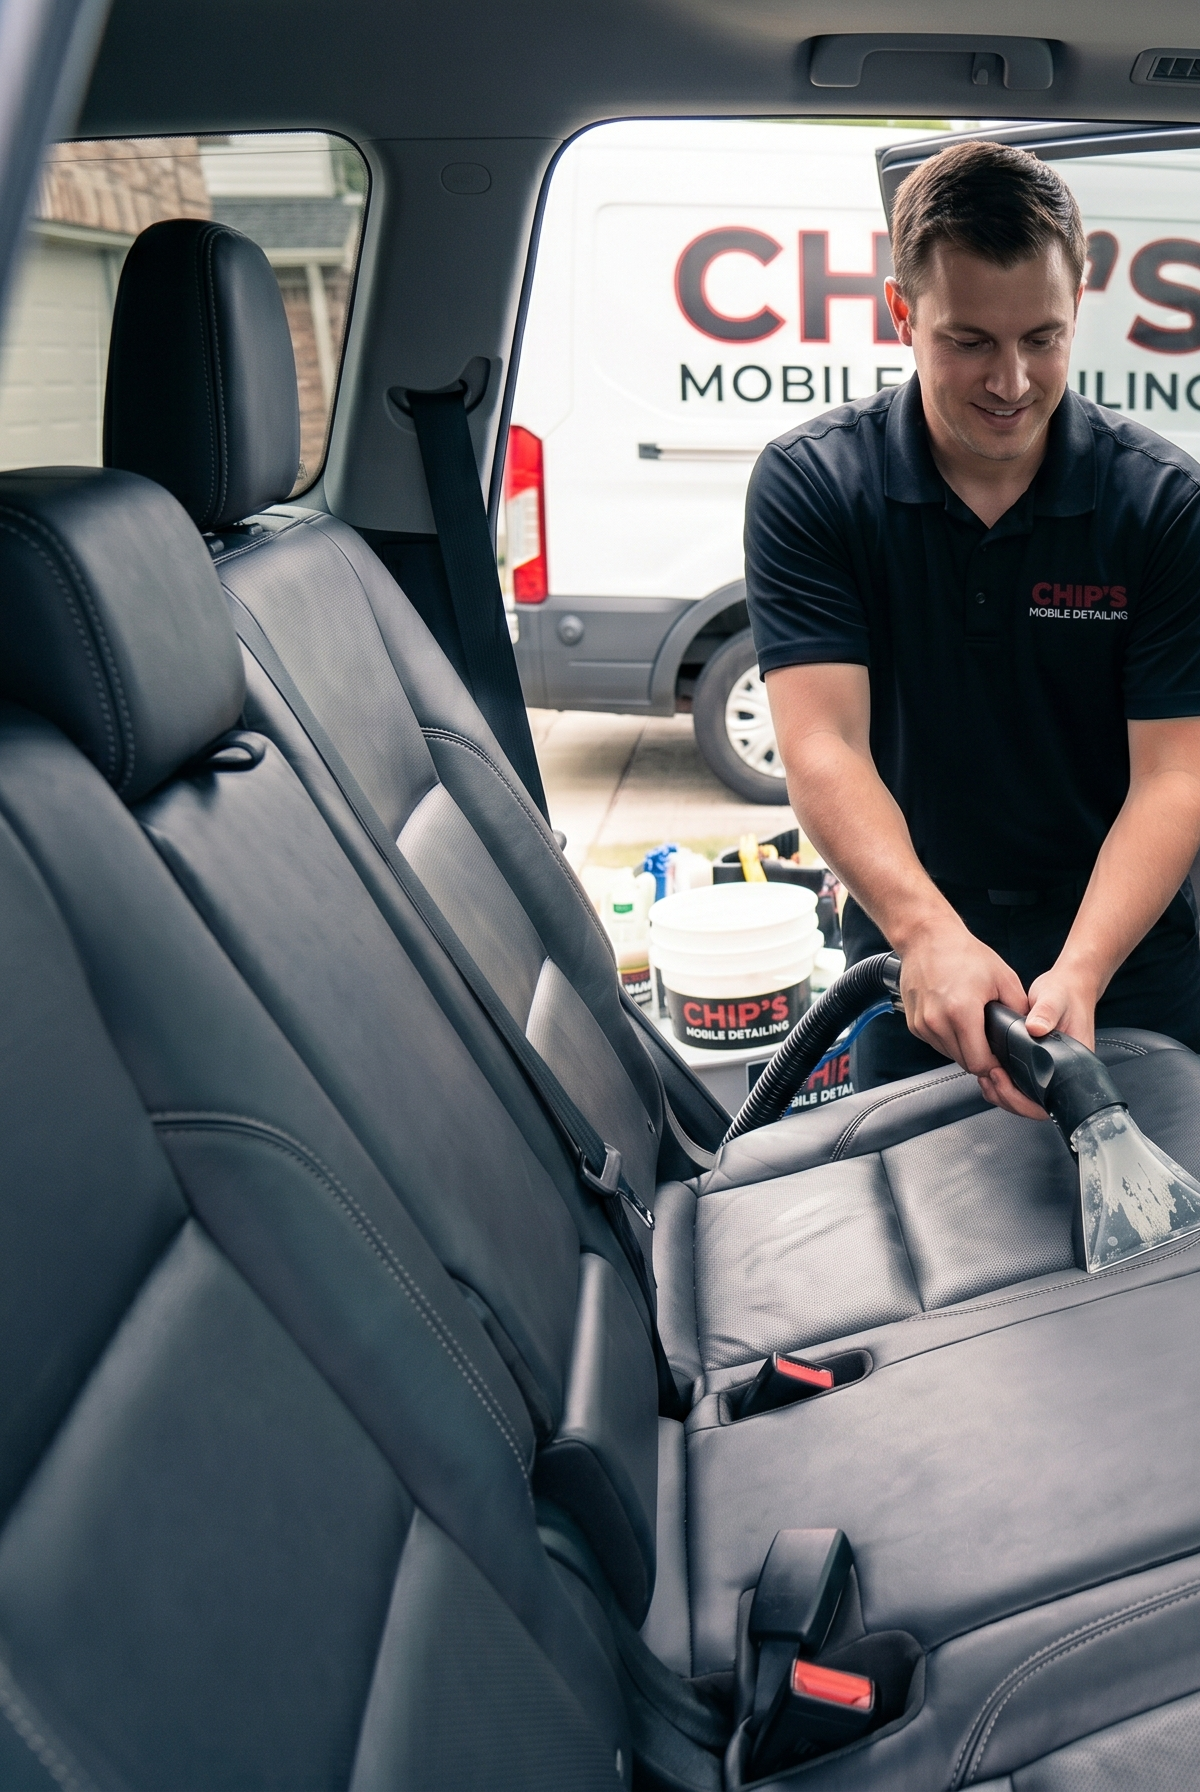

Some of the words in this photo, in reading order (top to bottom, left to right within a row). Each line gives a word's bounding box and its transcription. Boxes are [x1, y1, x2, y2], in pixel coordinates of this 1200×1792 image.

[1031, 581, 1128, 608] CHIP'S
[1029, 607, 1071, 619] MOBILE
[1072, 609, 1128, 620] DETAILING
[683, 995, 789, 1028] CHIP'S
[728, 1020, 790, 1040] DETAILING
